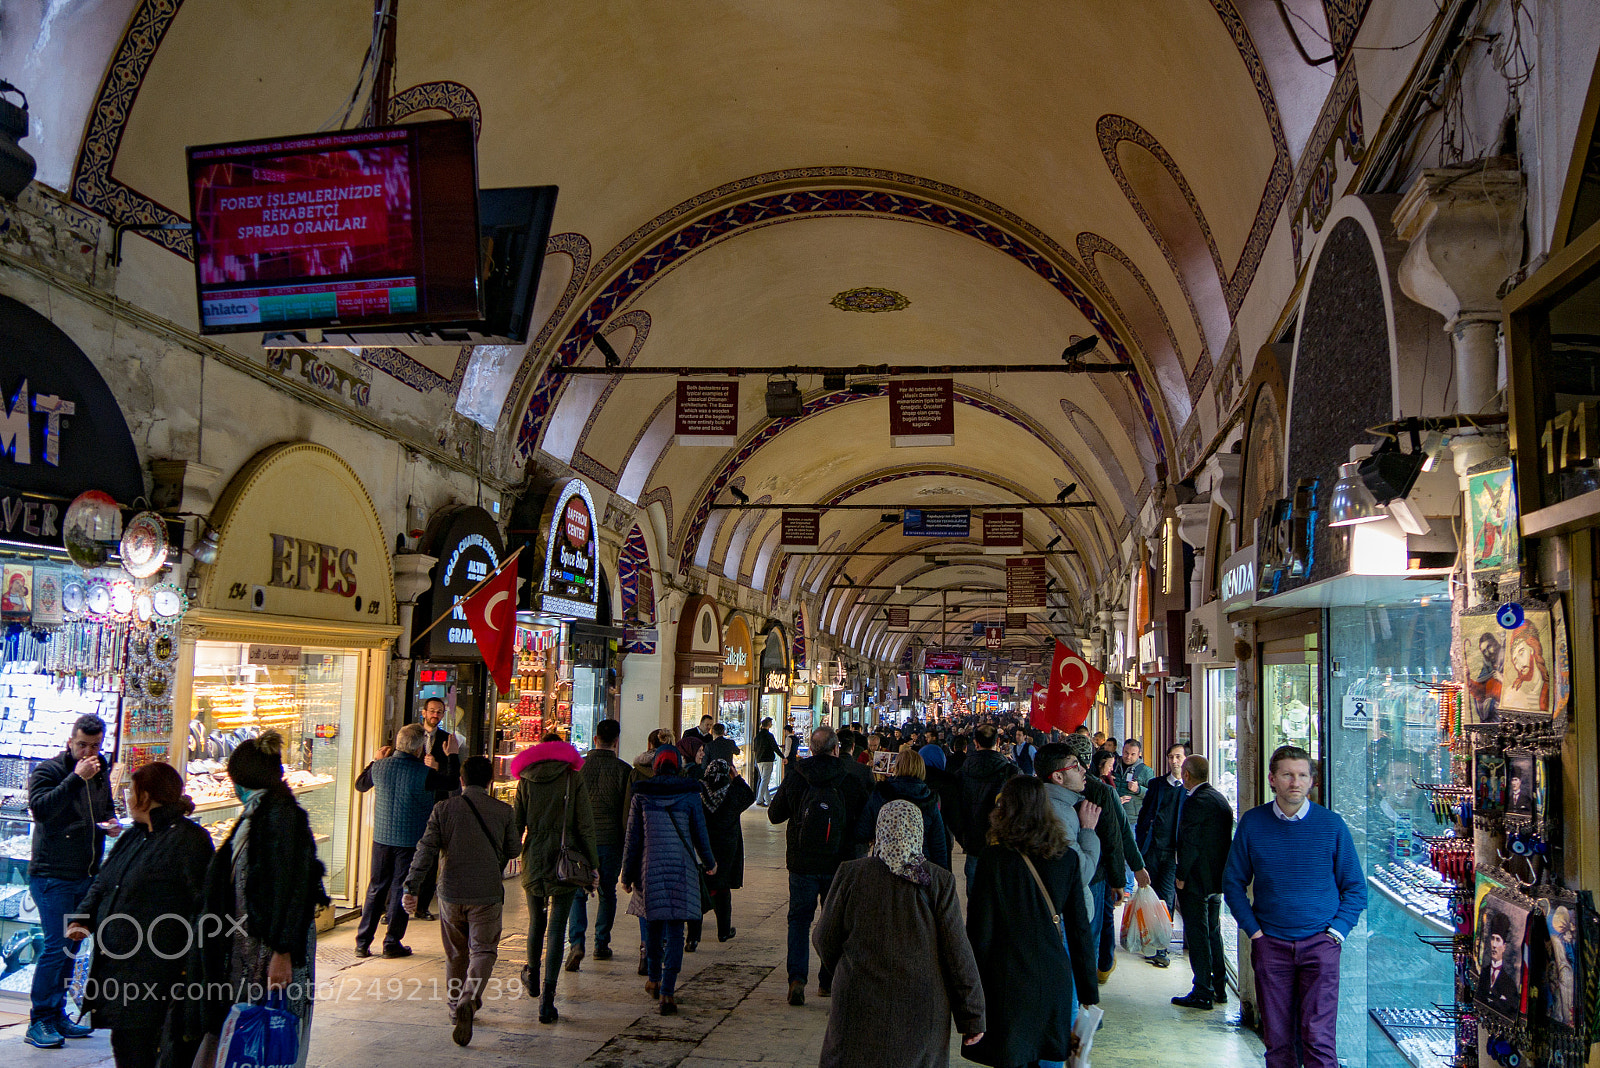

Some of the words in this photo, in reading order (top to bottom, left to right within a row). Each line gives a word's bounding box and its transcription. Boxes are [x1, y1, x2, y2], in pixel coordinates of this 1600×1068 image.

[220, 195, 263, 212] FOREX
[266, 184, 382, 209] İŞLEMLERİNİZDE
[262, 202, 339, 222] REKABETÇİ
[238, 223, 290, 240] SPREAD
[294, 216, 368, 235] ORANLARI
[1540, 402, 1587, 475] 171
[567, 506, 588, 528] SAFFRON
[567, 523, 585, 541] CENTER
[269, 532, 358, 598] EFES
[560, 545, 575, 568] Spice
[575, 550, 588, 574] Shop
[228, 583, 247, 600] 134
